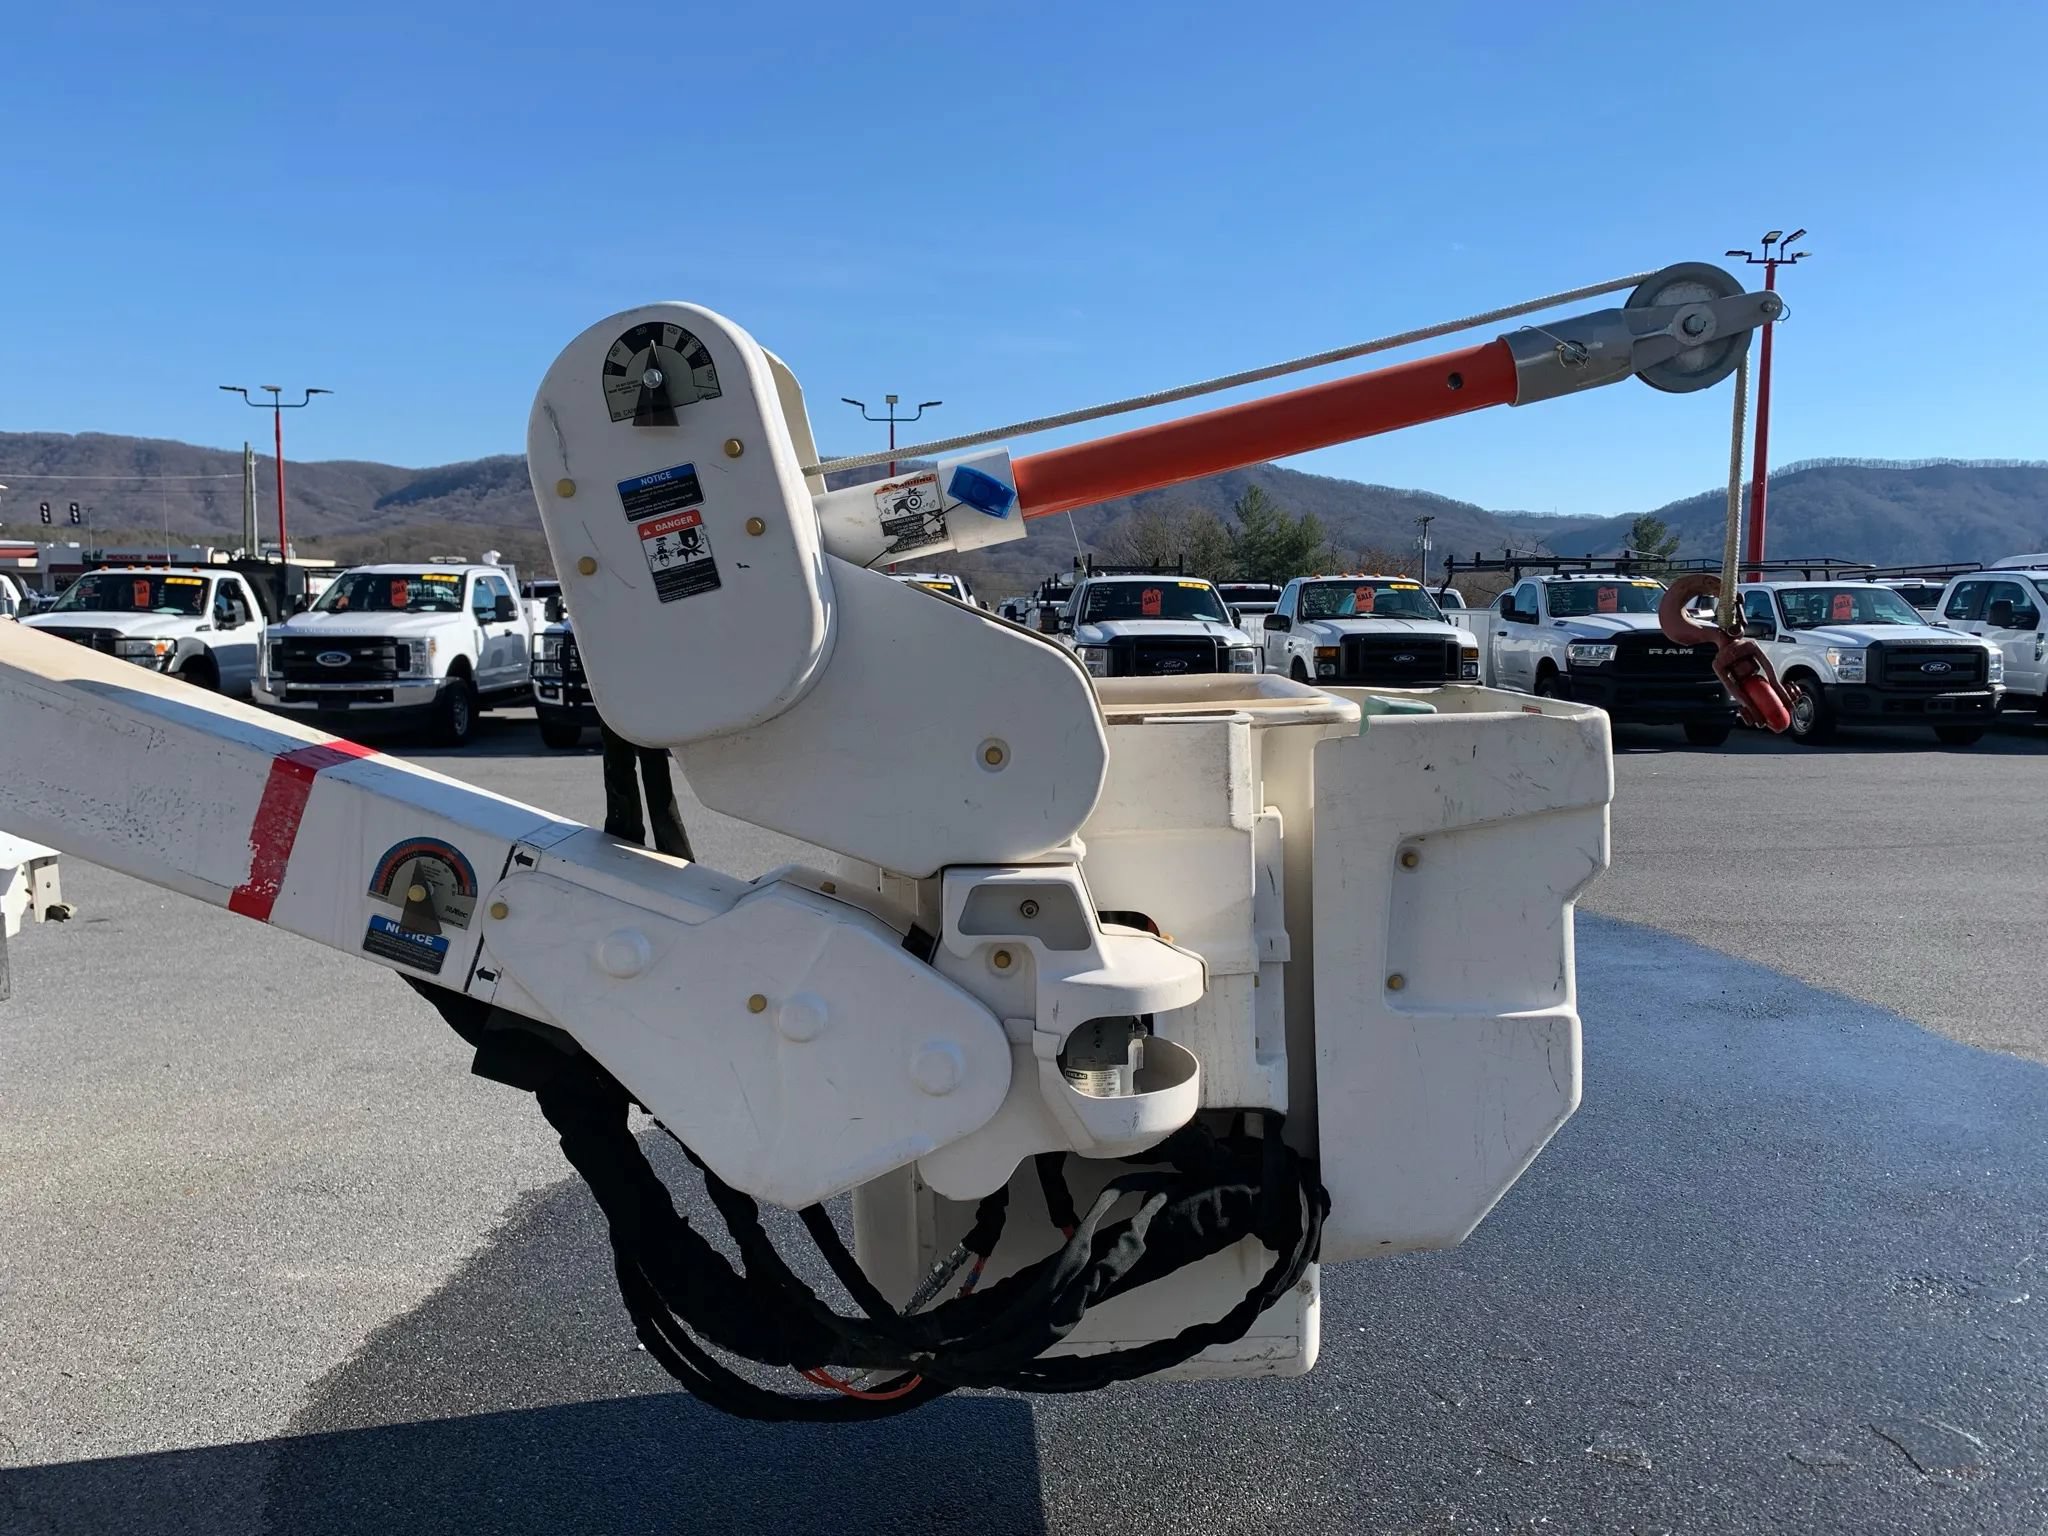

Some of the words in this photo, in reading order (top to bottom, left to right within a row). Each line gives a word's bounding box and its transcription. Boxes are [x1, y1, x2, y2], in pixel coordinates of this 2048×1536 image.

[667, 326, 678, 335] 400
[690, 339, 701, 349] 750
[640, 470, 673, 486] NOTICE
[655, 515, 694, 532] DANGER
[1143, 595, 1161, 605] SALE
[1357, 591, 1373, 602] SALE
[1599, 590, 1616, 602] SALE
